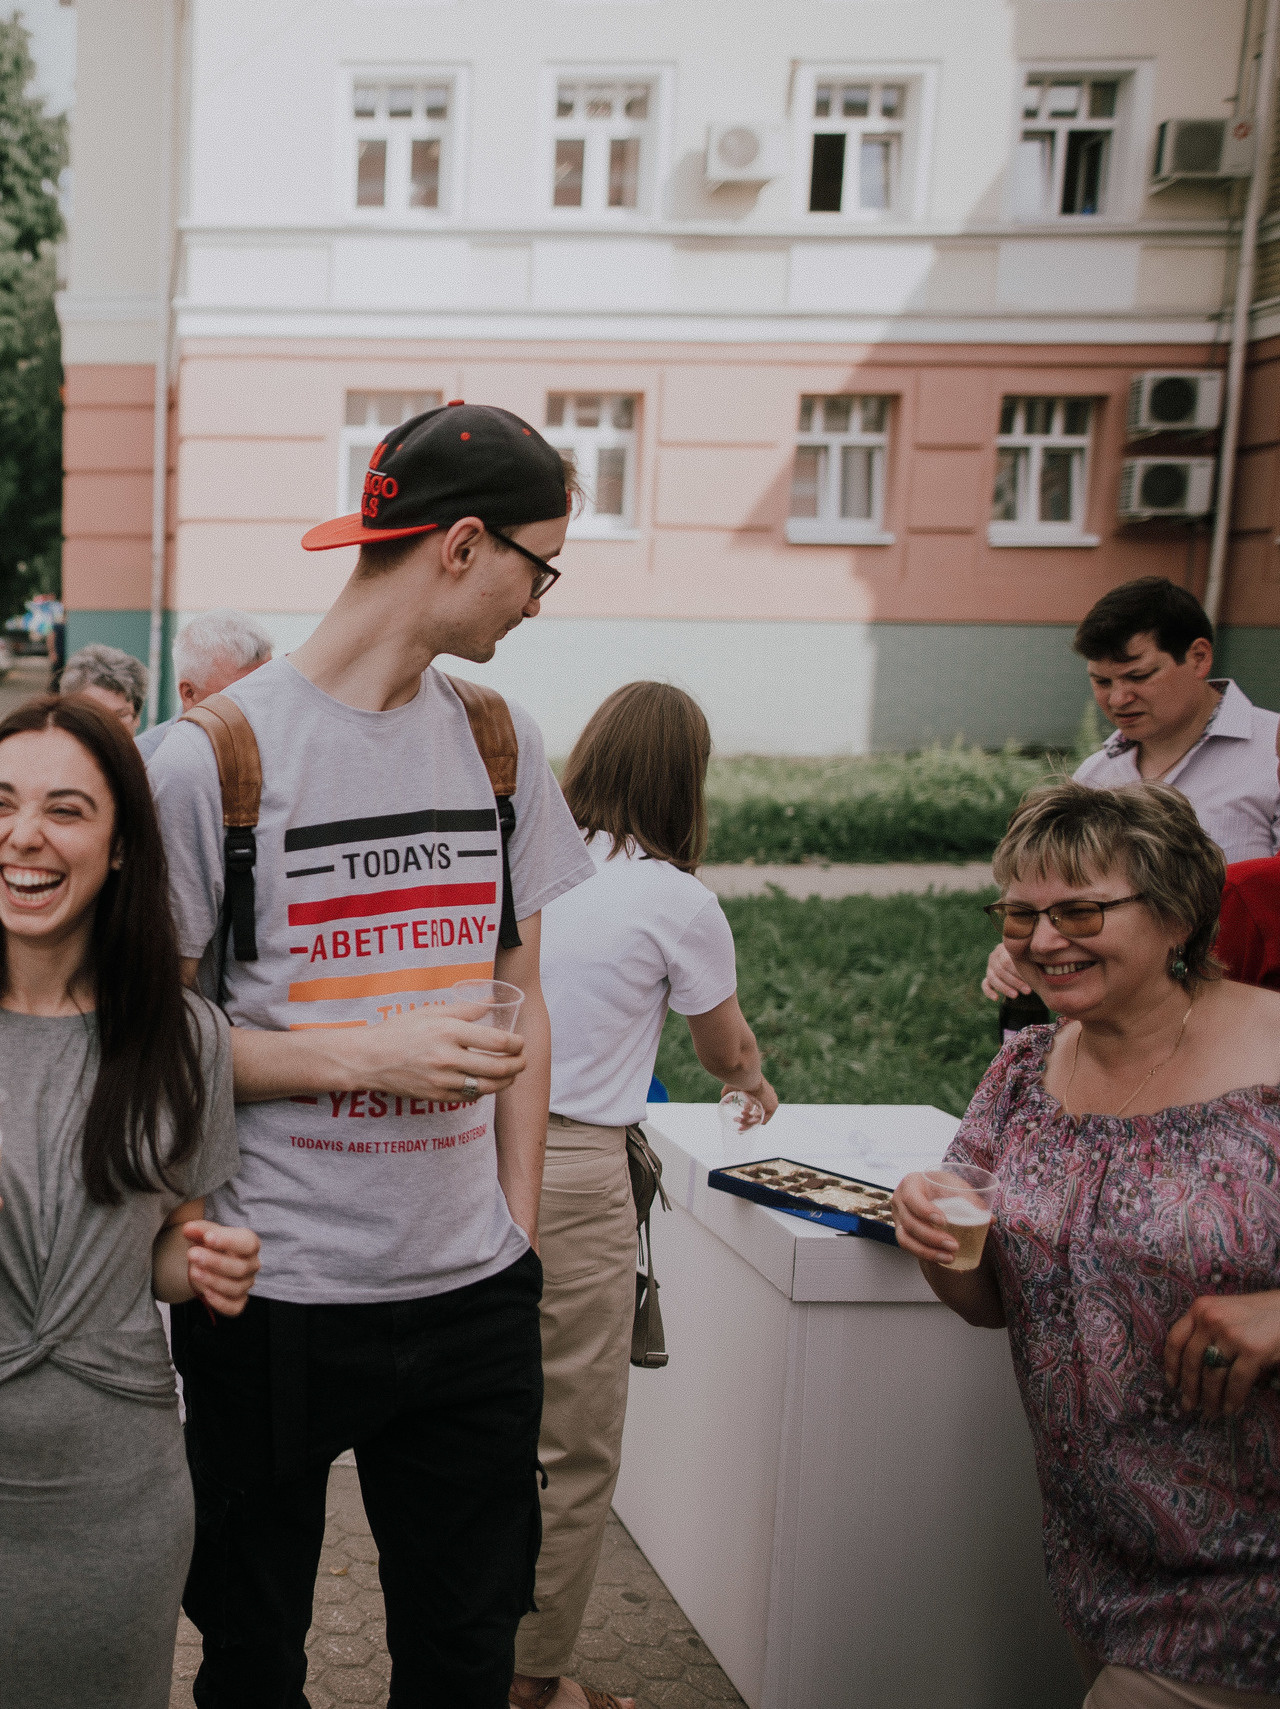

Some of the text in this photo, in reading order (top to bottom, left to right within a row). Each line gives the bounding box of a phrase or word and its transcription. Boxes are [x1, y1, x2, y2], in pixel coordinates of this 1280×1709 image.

[343, 843, 451, 879] TODAYS
[310, 916, 486, 962] ABETTERDAY
[432, 1135, 455, 1150] THAN
